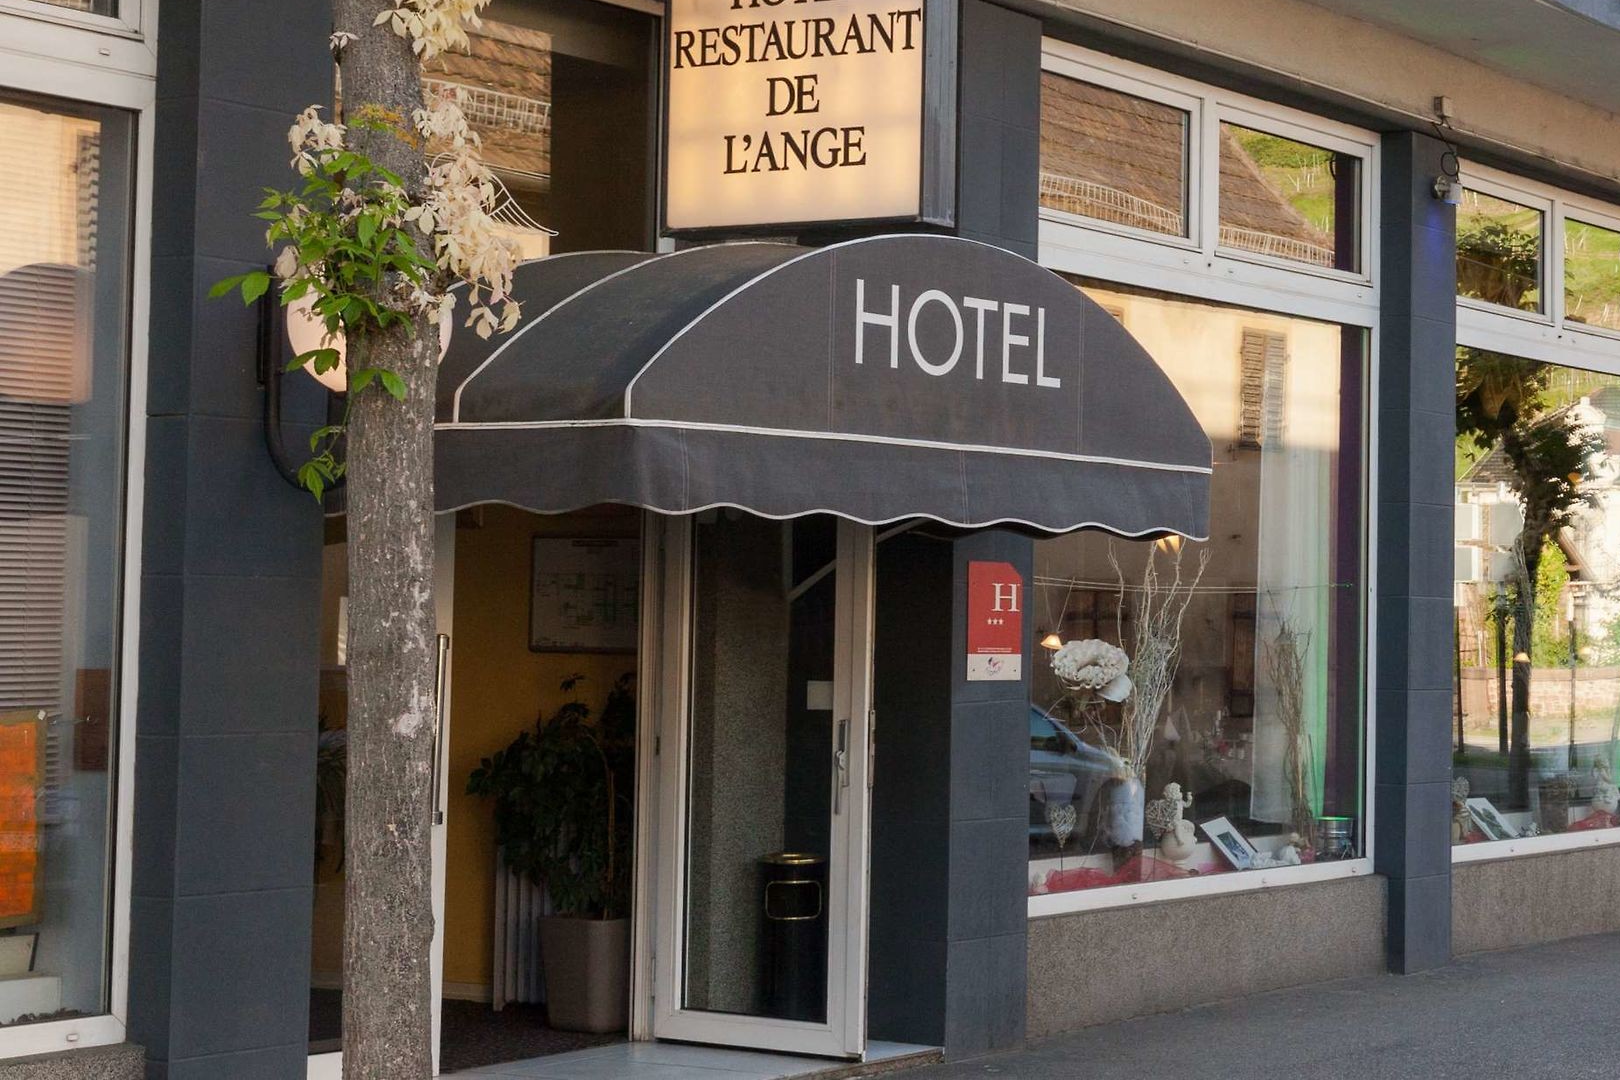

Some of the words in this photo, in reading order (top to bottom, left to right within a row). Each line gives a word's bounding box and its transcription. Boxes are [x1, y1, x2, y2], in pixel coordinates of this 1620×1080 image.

[673, 8, 922, 69] RESTAURANT
[765, 74, 820, 117] DE
[723, 126, 867, 175] L'ANGE
[855, 278, 1061, 388] HOTEL
[991, 583, 1020, 612] H
